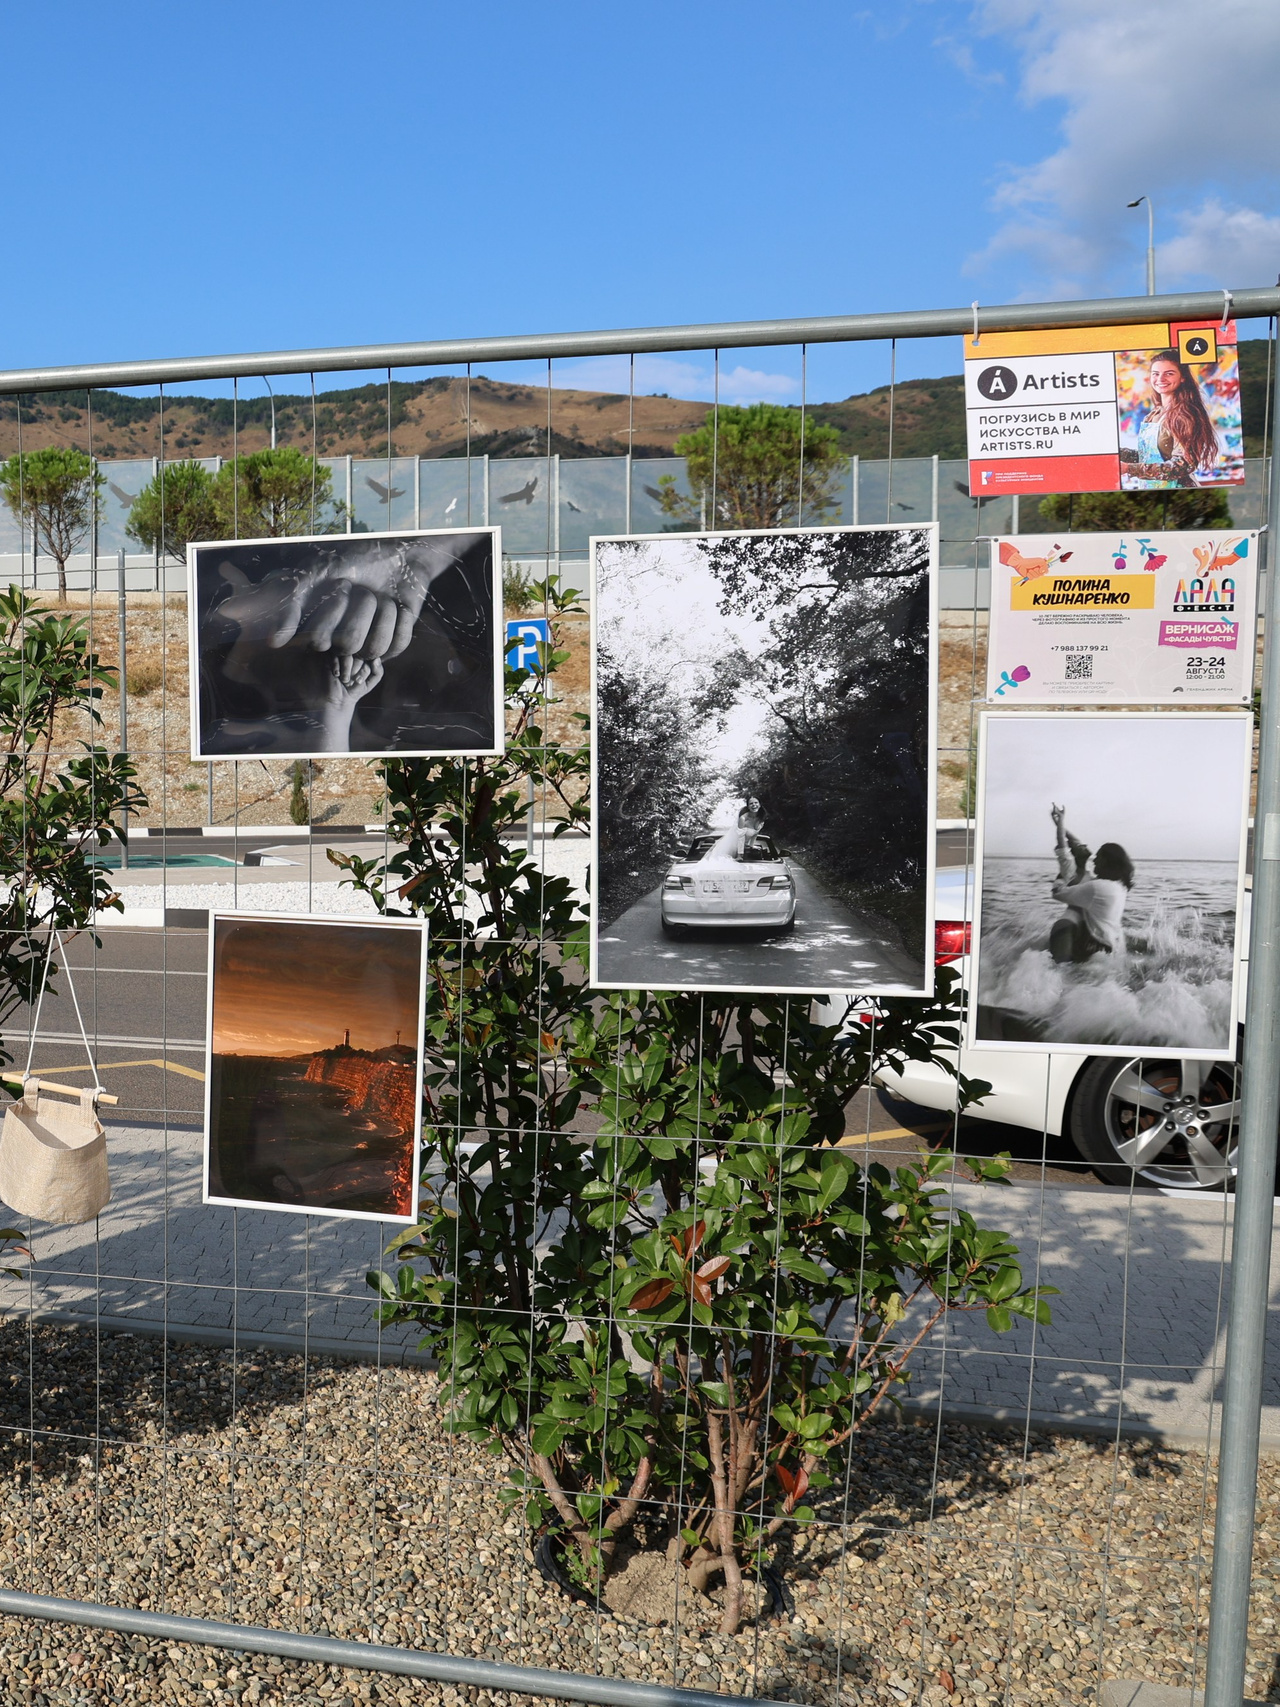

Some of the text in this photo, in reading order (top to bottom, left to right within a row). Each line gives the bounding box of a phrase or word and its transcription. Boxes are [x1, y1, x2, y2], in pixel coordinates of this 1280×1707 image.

[1022, 371, 1100, 391] Artists
[979, 410, 1101, 425] ПОГРУЗИСЬ В МИР
[980, 425, 1081, 438] ИСКУССТВА НА
[980, 440, 1054, 452] ARTISTS.RU
[1053, 579, 1111, 592] ПОЛИНА
[1173, 578, 1235, 603] ЛАЛА
[1032, 592, 1131, 605] КУШНАРЕНКО
[1165, 624, 1235, 634] ВЕРНИСАЖ
[1164, 635, 1202, 643] «ФАСАДЫ
[518, 626, 542, 669] P
[1186, 656, 1226, 667] 23-24
